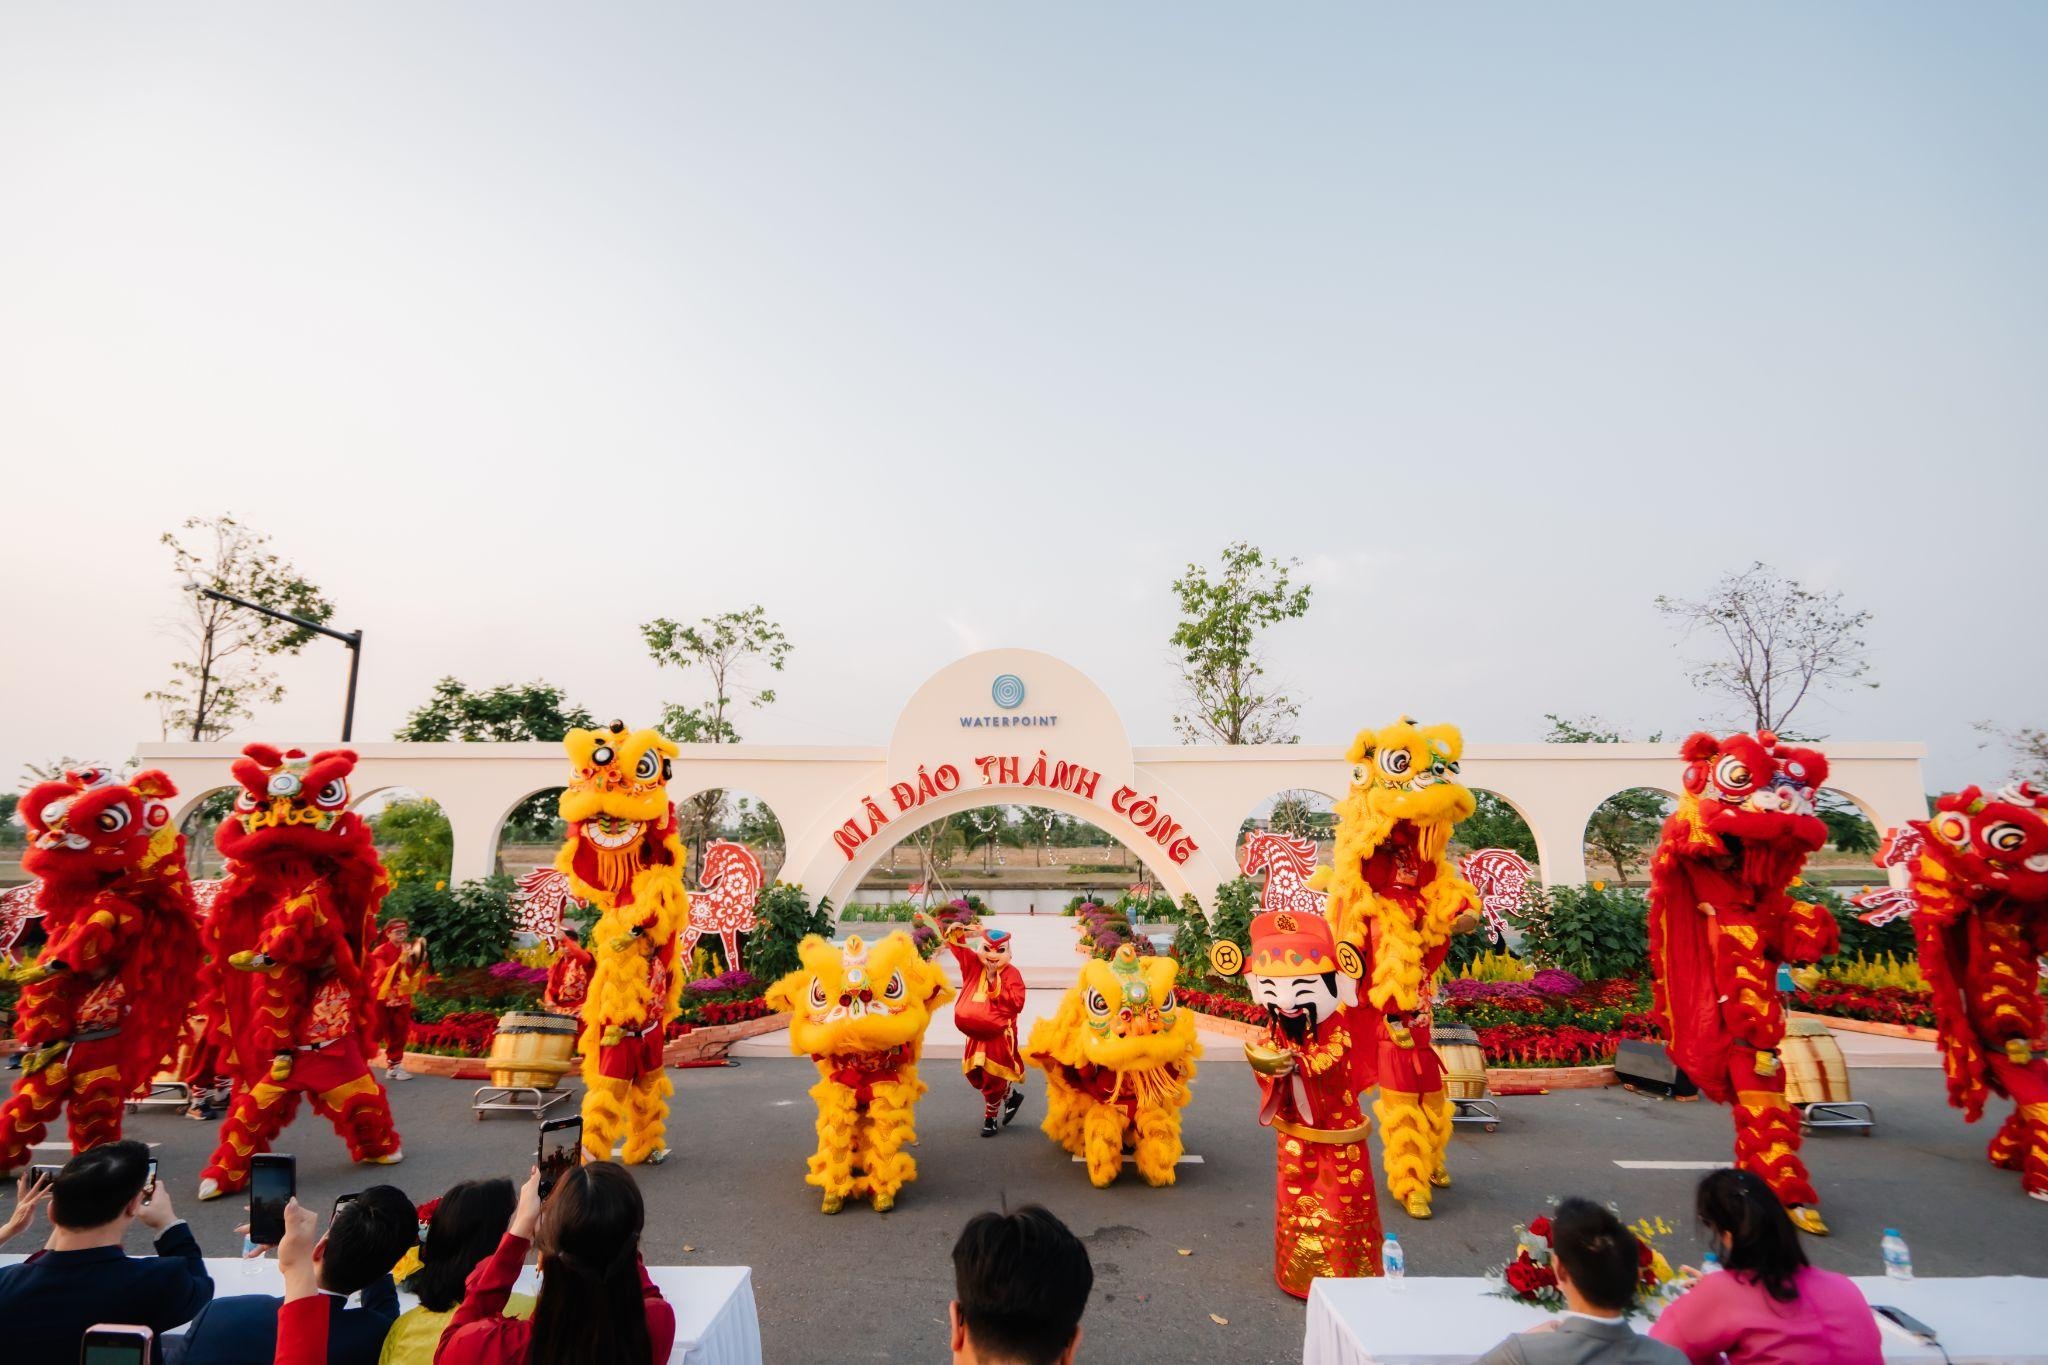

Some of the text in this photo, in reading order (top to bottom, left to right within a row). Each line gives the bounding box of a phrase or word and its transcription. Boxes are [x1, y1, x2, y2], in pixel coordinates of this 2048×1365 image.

[960, 716, 1057, 727] WATERPOINT
[834, 750, 1199, 865] MÃ ĐÁO THÀNH CÔNG
